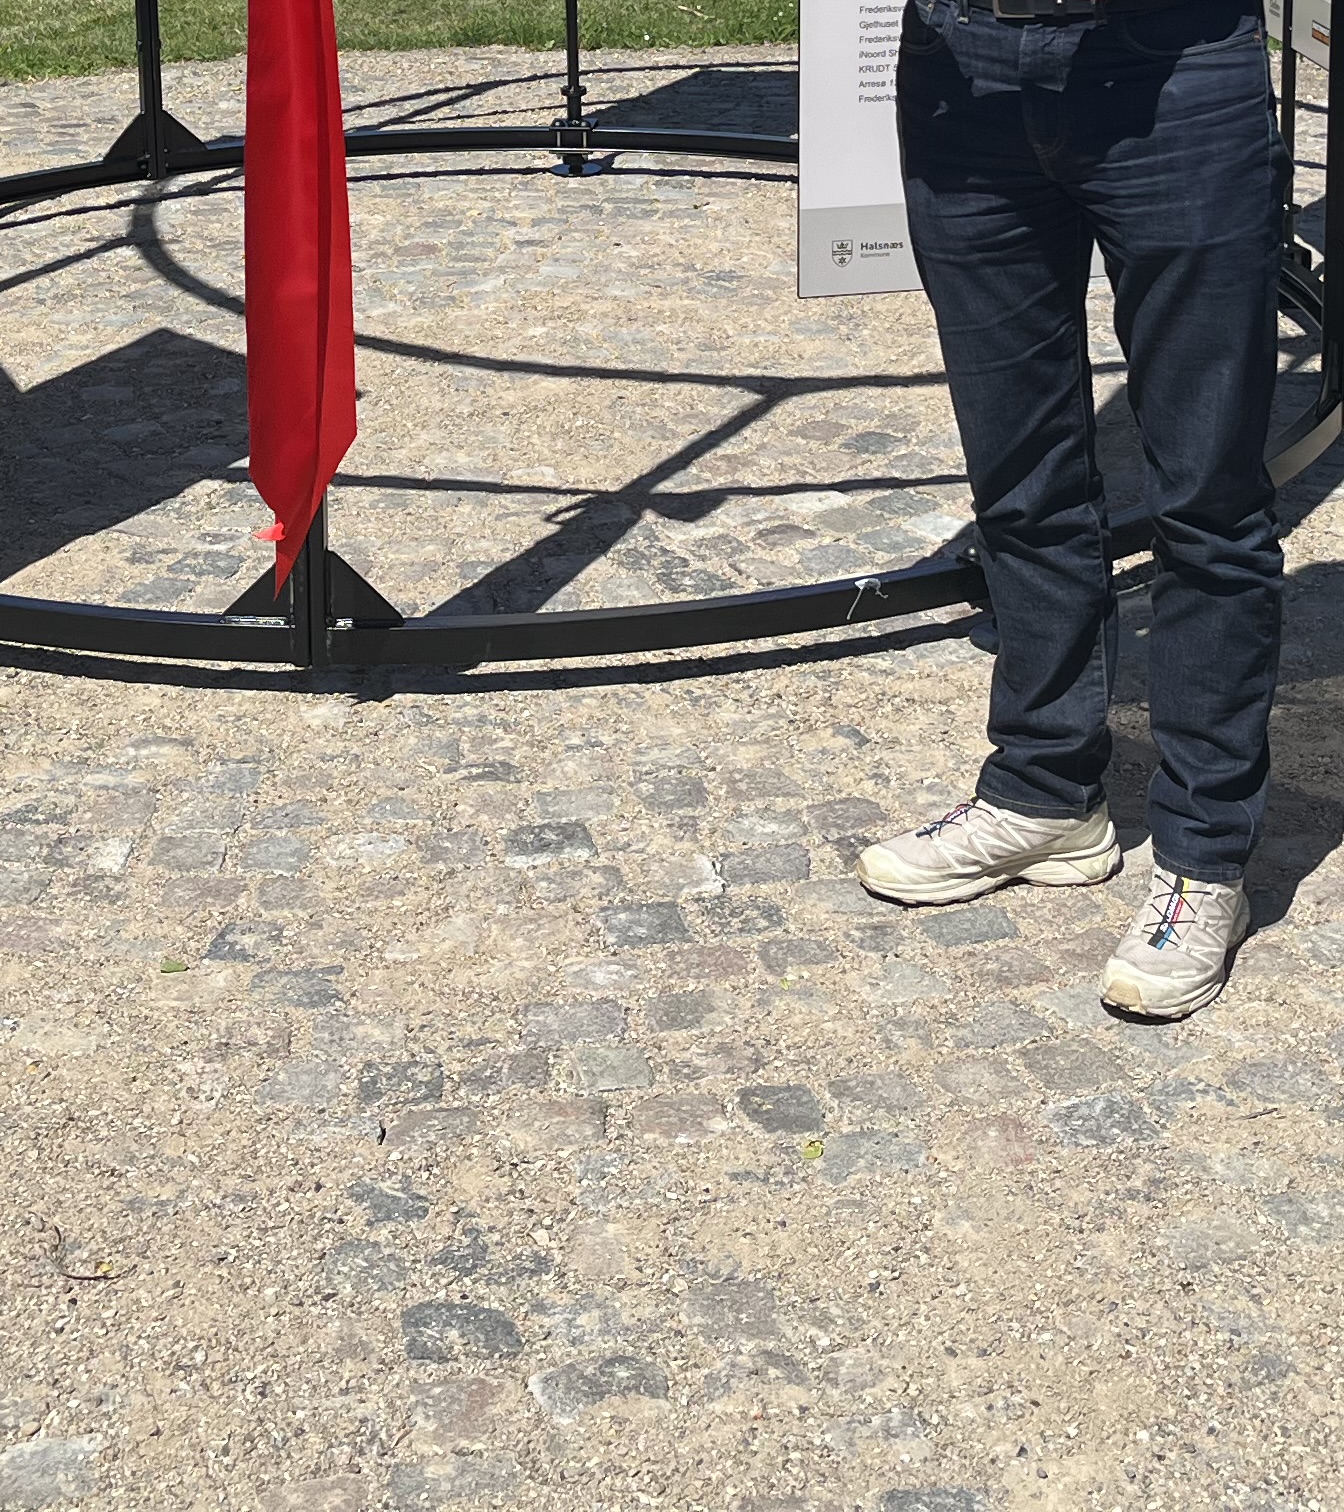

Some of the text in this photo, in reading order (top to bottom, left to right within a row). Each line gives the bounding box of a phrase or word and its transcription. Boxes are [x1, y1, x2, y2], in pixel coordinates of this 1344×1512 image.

[859, 5, 904, 14] Frederiksv
[859, 20, 898, 30] Gjethuset
[858, 64, 890, 73] KRUDT
[860, 241, 904, 251] Halsnæs
